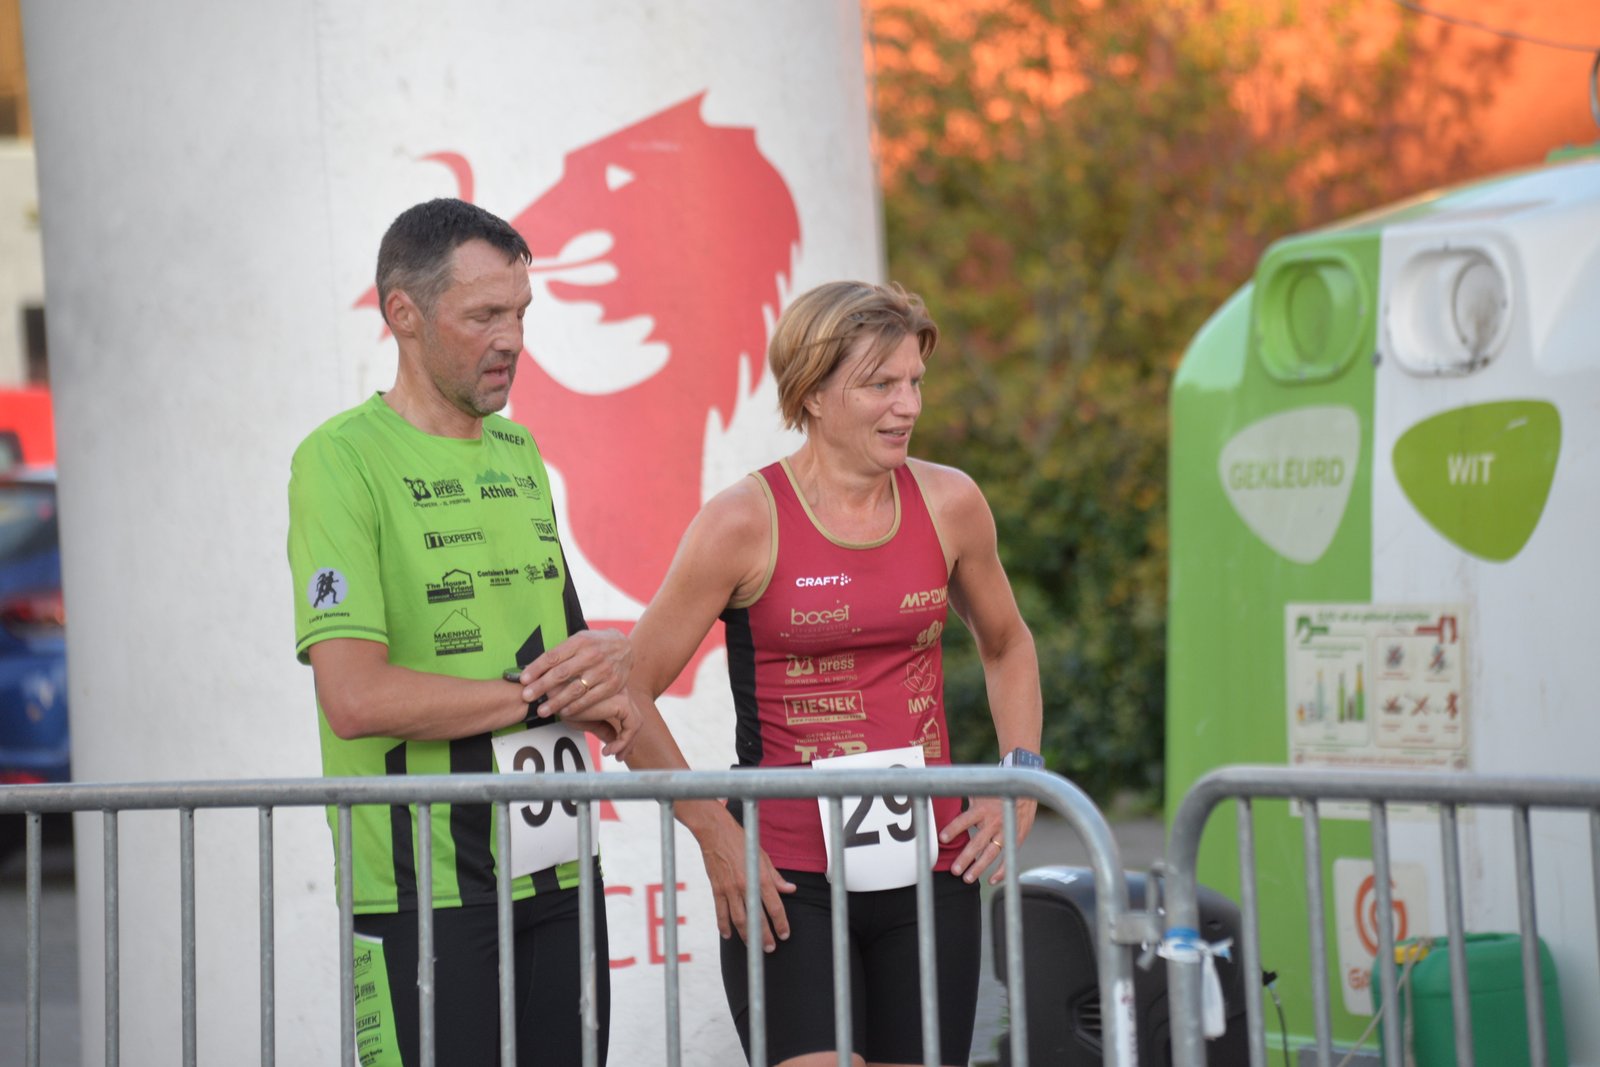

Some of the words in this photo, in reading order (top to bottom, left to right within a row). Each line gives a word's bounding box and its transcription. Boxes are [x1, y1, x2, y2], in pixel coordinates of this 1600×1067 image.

[1229, 457, 1346, 490] GEKLEURD
[1448, 453, 1495, 485] WIT
[433, 484, 464, 498] press
[480, 484, 518, 499] Athlex
[443, 531, 483, 544] EXPERTS
[795, 575, 840, 587] CRAFT
[434, 629, 480, 640] MAENHOUT
[819, 659, 855, 674] press
[792, 696, 857, 714] FIESIEK
[513, 737, 588, 828] 30
[839, 764, 917, 849] 29
